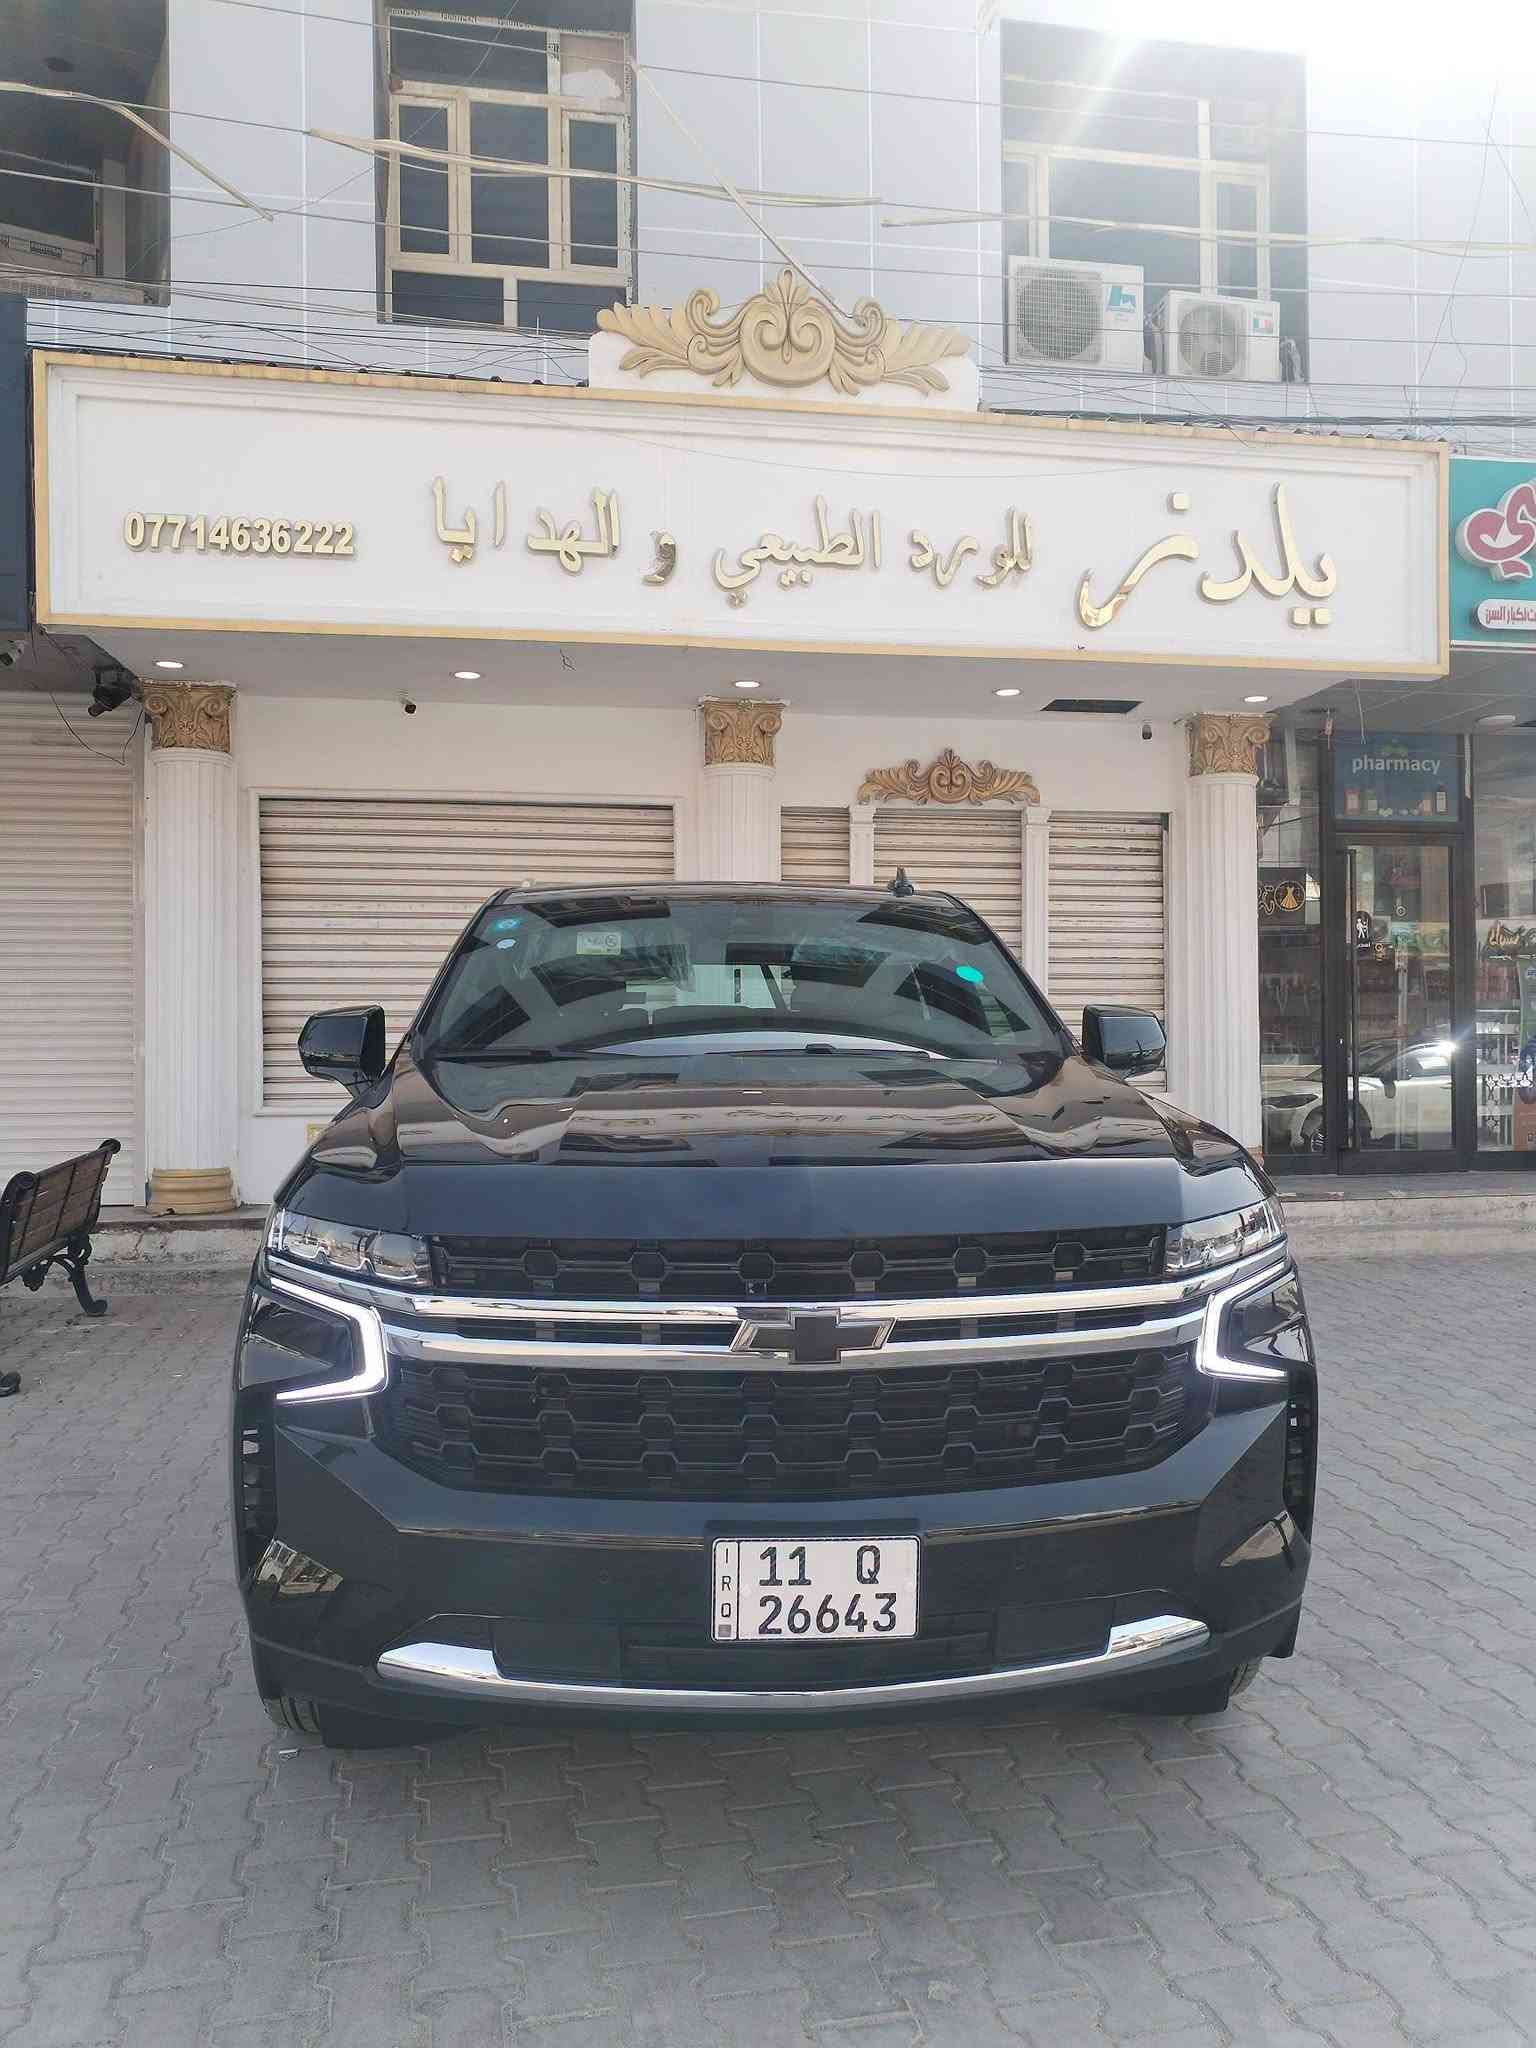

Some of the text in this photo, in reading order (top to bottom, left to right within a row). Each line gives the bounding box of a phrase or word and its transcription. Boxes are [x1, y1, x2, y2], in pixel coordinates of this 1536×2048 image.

[124, 511, 354, 555] 07714636222
[711, 494, 881, 608] الطبيعي
[909, 504, 1032, 586] الورد
[641, 530, 676, 584] و
[1351, 754, 1441, 775] pharmacy
[759, 1545, 881, 1586] 11 Q
[758, 1592, 897, 1635] 26643
